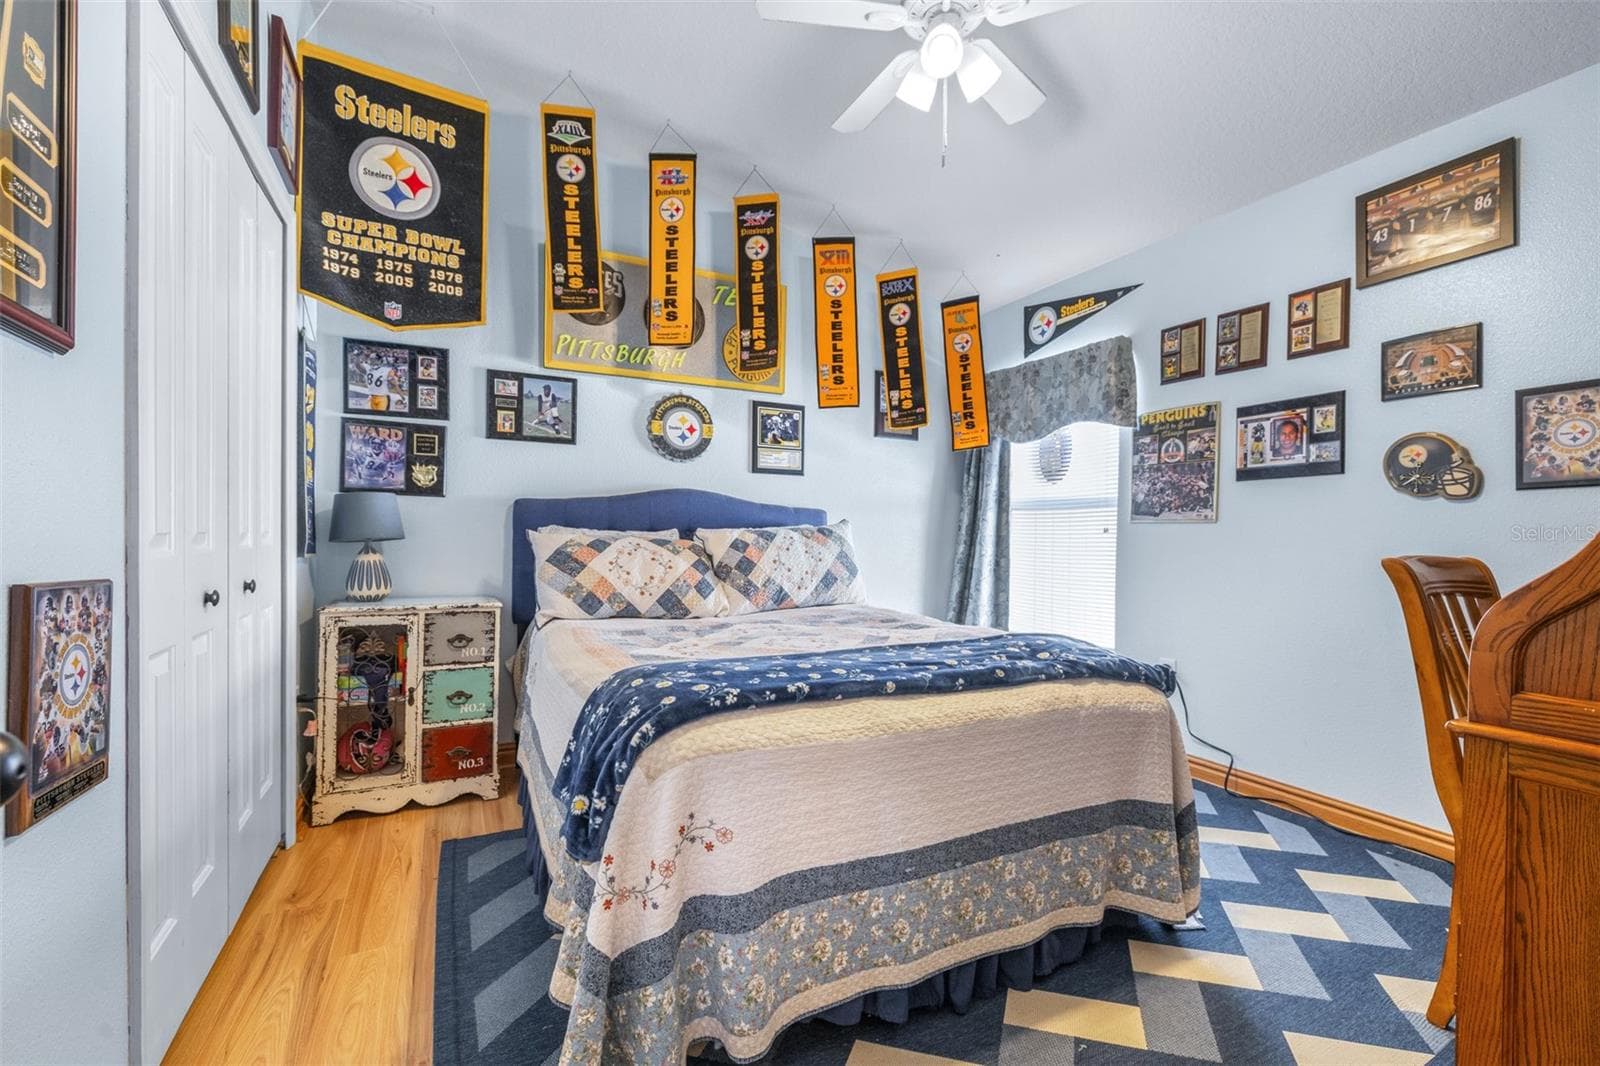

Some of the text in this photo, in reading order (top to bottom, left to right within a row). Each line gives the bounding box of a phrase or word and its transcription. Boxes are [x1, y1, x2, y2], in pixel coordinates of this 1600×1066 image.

[335, 84, 456, 149] Steelers
[550, 143, 591, 156] Pittsburgh
[363, 167, 393, 181] Steelers
[655, 188, 691, 197] Pittsburgh
[1474, 192, 1492, 211] 86
[1409, 218, 1415, 232] 1
[1442, 206, 1451, 222] 7
[321, 211, 466, 256] SUPER BOWL
[563, 184, 585, 289] STEELERS
[1373, 228, 1388, 244] 43
[327, 229, 460, 269] CHAMPIONS
[322, 246, 463, 283] 1974 1975 1978
[663, 225, 680, 322] STEELERS
[322, 259, 463, 297] 1979 2005 2008
[602, 270, 623, 297] ES
[751, 260, 767, 351] STEELERS
[1060, 296, 1095, 317] Steelers
[556, 333, 687, 372] PITTSBURGH
[829, 299, 845, 385] STEELERS
[895, 326, 914, 410] STEELERS
[959, 353, 976, 430] STEELERS
[1141, 404, 1207, 426] PENGUINS
[349, 425, 403, 442] WARD
[461, 647, 486, 658] NO.1
[459, 702, 486, 714] NO.2
[457, 757, 484, 770] NO.3
